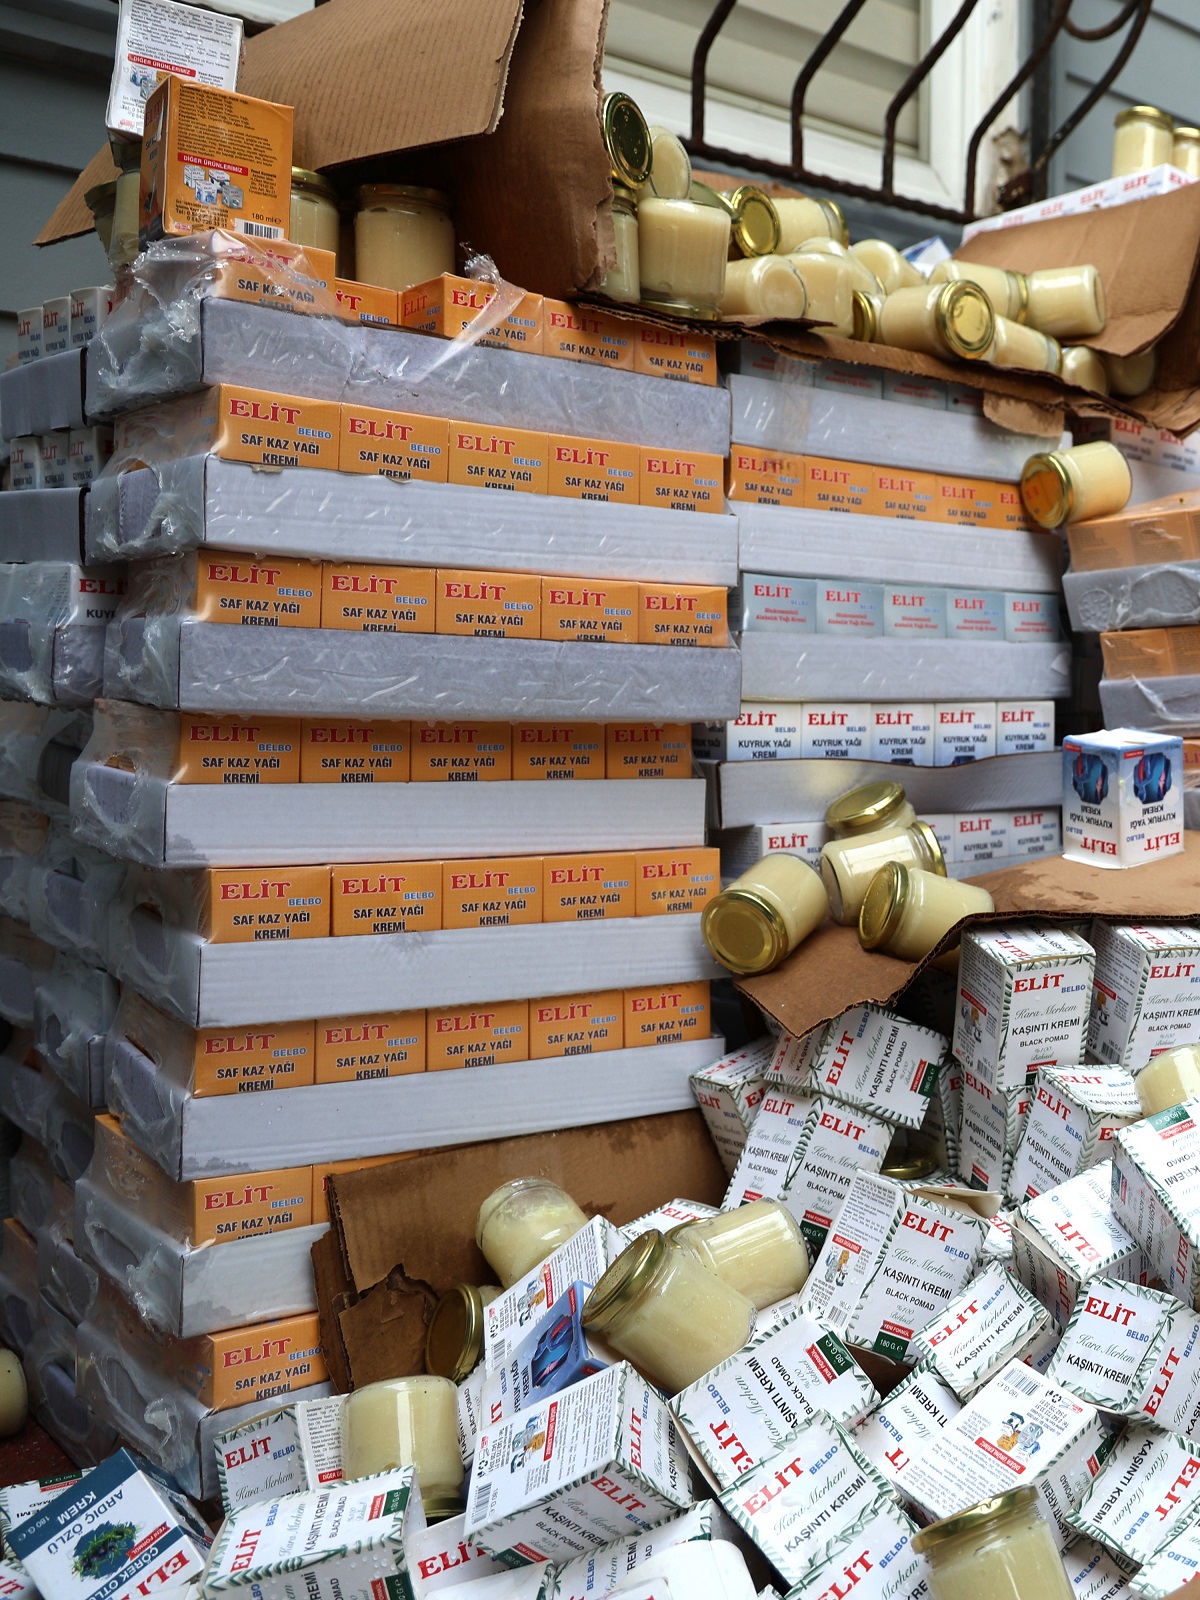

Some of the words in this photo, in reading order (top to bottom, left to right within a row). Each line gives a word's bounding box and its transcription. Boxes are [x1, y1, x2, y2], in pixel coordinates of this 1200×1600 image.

[133, 56, 151, 66] DİĞER
[152, 60, 190, 75] ÜRÜNLERİMİZ
[183, 155, 202, 164] DİĞER
[203, 159, 243, 173] ÜRÜNLERİMİZ
[252, 212, 264, 220] 180
[550, 312, 604, 334] ELİT
[602, 336, 627, 346] BELBO
[229, 398, 301, 425] ELİT
[298, 427, 332, 439] BELBO
[241, 433, 263, 446] SAF
[267, 437, 289, 450] KAZ
[293, 439, 320, 455] YAĞI
[262, 452, 299, 466] KREMİ
[878, 476, 916, 493] ELİT
[207, 563, 281, 586] ELİT
[278, 587, 313, 598] BELBO
[753, 584, 792, 599] ELİT
[220, 597, 242, 610] SAF
[246, 600, 268, 612] KAZ
[273, 600, 300, 615] YAĞI
[241, 615, 279, 626] KREMİ
[807, 710, 848, 726] ELİT
[520, 726, 574, 743] ELİT
[572, 743, 599, 751] BELBO
[812, 738, 847, 748] KUYRUK
[529, 756, 547, 766] SAF
[549, 755, 567, 765] KAZ
[569, 754, 590, 766] YAĞI
[825, 748, 848, 758] KREMİ
[546, 768, 574, 779] KREMİ
[1142, 804, 1163, 816] KREMİ
[1148, 812, 1176, 825] KUYRUK
[959, 819, 992, 833] ELİT
[1130, 818, 1147, 829] YAĞI
[1126, 833, 1144, 842] BELBO
[1144, 832, 1180, 851] ELİT
[341, 874, 406, 895] ELİT
[404, 891, 435, 900] BELBO
[353, 908, 373, 919] SAF
[377, 906, 396, 917] KAZ
[400, 903, 424, 916] YAĞI
[372, 919, 406, 933] KREMİ
[1013, 974, 1065, 994] ELİT
[1061, 984, 1086, 994] BELBO
[631, 993, 682, 1013] ELİT
[680, 1005, 705, 1015] BELBO
[1015, 1007, 1040, 1020] Kara
[1040, 1003, 1078, 1018] Merhem
[640, 1023, 657, 1033] SAF
[659, 1020, 675, 1030] KAZ
[677, 1016, 697, 1028] YAĞI
[1012, 1022, 1048, 1037] KAŞINTI
[1050, 1017, 1080, 1032] KREMİ
[825, 1030, 856, 1086] ELİT
[856, 1011, 870, 1039] BELBO
[1020, 1036, 1043, 1048] BLACK
[1049, 1033, 1069, 1044] POMAD
[855, 1066, 871, 1092] Kara
[863, 1024, 885, 1067] Merhem
[868, 1060, 890, 1098] KAŞINTI
[883, 1026, 900, 1058] KREMİ
[884, 1067, 898, 1093] BLACK
[893, 1040, 908, 1068] POMAD
[204, 1185, 274, 1211] ELİT
[271, 1196, 304, 1209] BELBO
[216, 1222, 238, 1234] SAF
[241, 1217, 264, 1230] KAZ
[267, 1210, 293, 1225] YAĞI
[902, 1211, 953, 1242] ELİT
[944, 1245, 970, 1261] BELBO
[892, 1248, 917, 1267] Kara
[916, 1259, 953, 1281] Merhem
[882, 1266, 921, 1289] KAŞINTI
[922, 1281, 952, 1300] KREMİ
[885, 1287, 908, 1302] BLACK
[908, 1295, 936, 1311] POMAD
[1084, 1296, 1136, 1327] ELİT
[1126, 1328, 1150, 1343] BELBO
[223, 1338, 292, 1368] ELİT
[289, 1346, 321, 1361] BELBO
[1076, 1333, 1101, 1350] Kara
[1100, 1343, 1136, 1364] Merhem
[235, 1377, 257, 1391] SAF
[259, 1371, 281, 1385] KAZ
[285, 1361, 310, 1378] YAĞI
[1066, 1353, 1104, 1374] KAŞINTI
[1103, 1364, 1133, 1386] KREMİ
[256, 1381, 292, 1400] KREMİ
[224, 1436, 272, 1470] ELİT
[272, 1444, 295, 1461] BELBO
[742, 1457, 804, 1516] ELİT
[809, 1445, 839, 1475] BELBO
[57, 1491, 97, 1525] KREM
[86, 1489, 124, 1524] ARDIÇ
[784, 1508, 831, 1553] KAŞINTI
[830, 1473, 868, 1514] KREMİ
[1123, 1510, 1150, 1541] BELBO
[47, 1523, 83, 1555] ÖZLÜ
[121, 1546, 159, 1581] ÇÖREK
